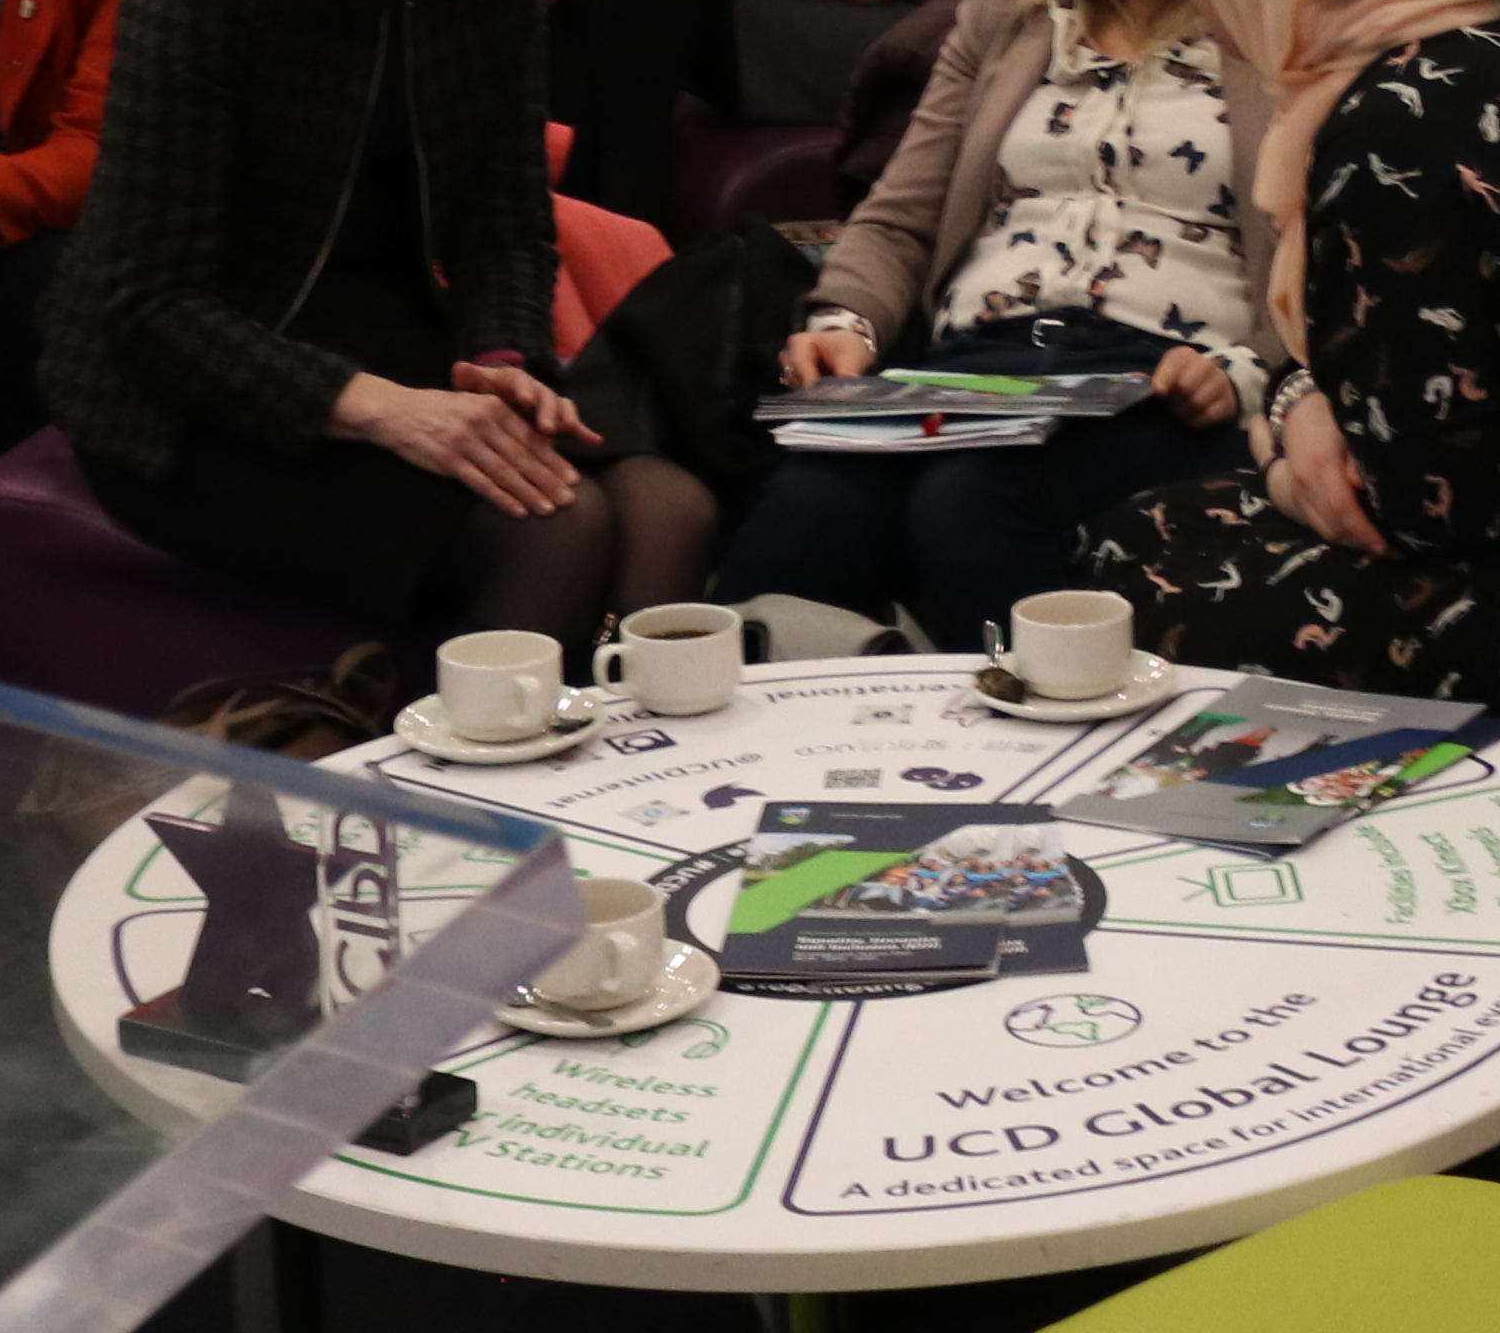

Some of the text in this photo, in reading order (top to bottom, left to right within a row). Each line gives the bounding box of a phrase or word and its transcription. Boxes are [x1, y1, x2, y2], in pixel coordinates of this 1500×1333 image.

[883, 971, 1479, 1162] UCD Global Lounge
[935, 991, 1317, 1109] Welcome to the
[550, 1058, 720, 1099] Wireless
[506, 1082, 693, 1125] headsets
[839, 1182, 871, 1199] A
[884, 1159, 1102, 1197] dedicated
[1112, 1136, 1229, 1172] space
[1229, 1117, 1291, 1141] for
[1287, 1027, 1486, 1123] international
[498, 1112, 712, 1159] individual
[485, 1139, 669, 1182] Stations
